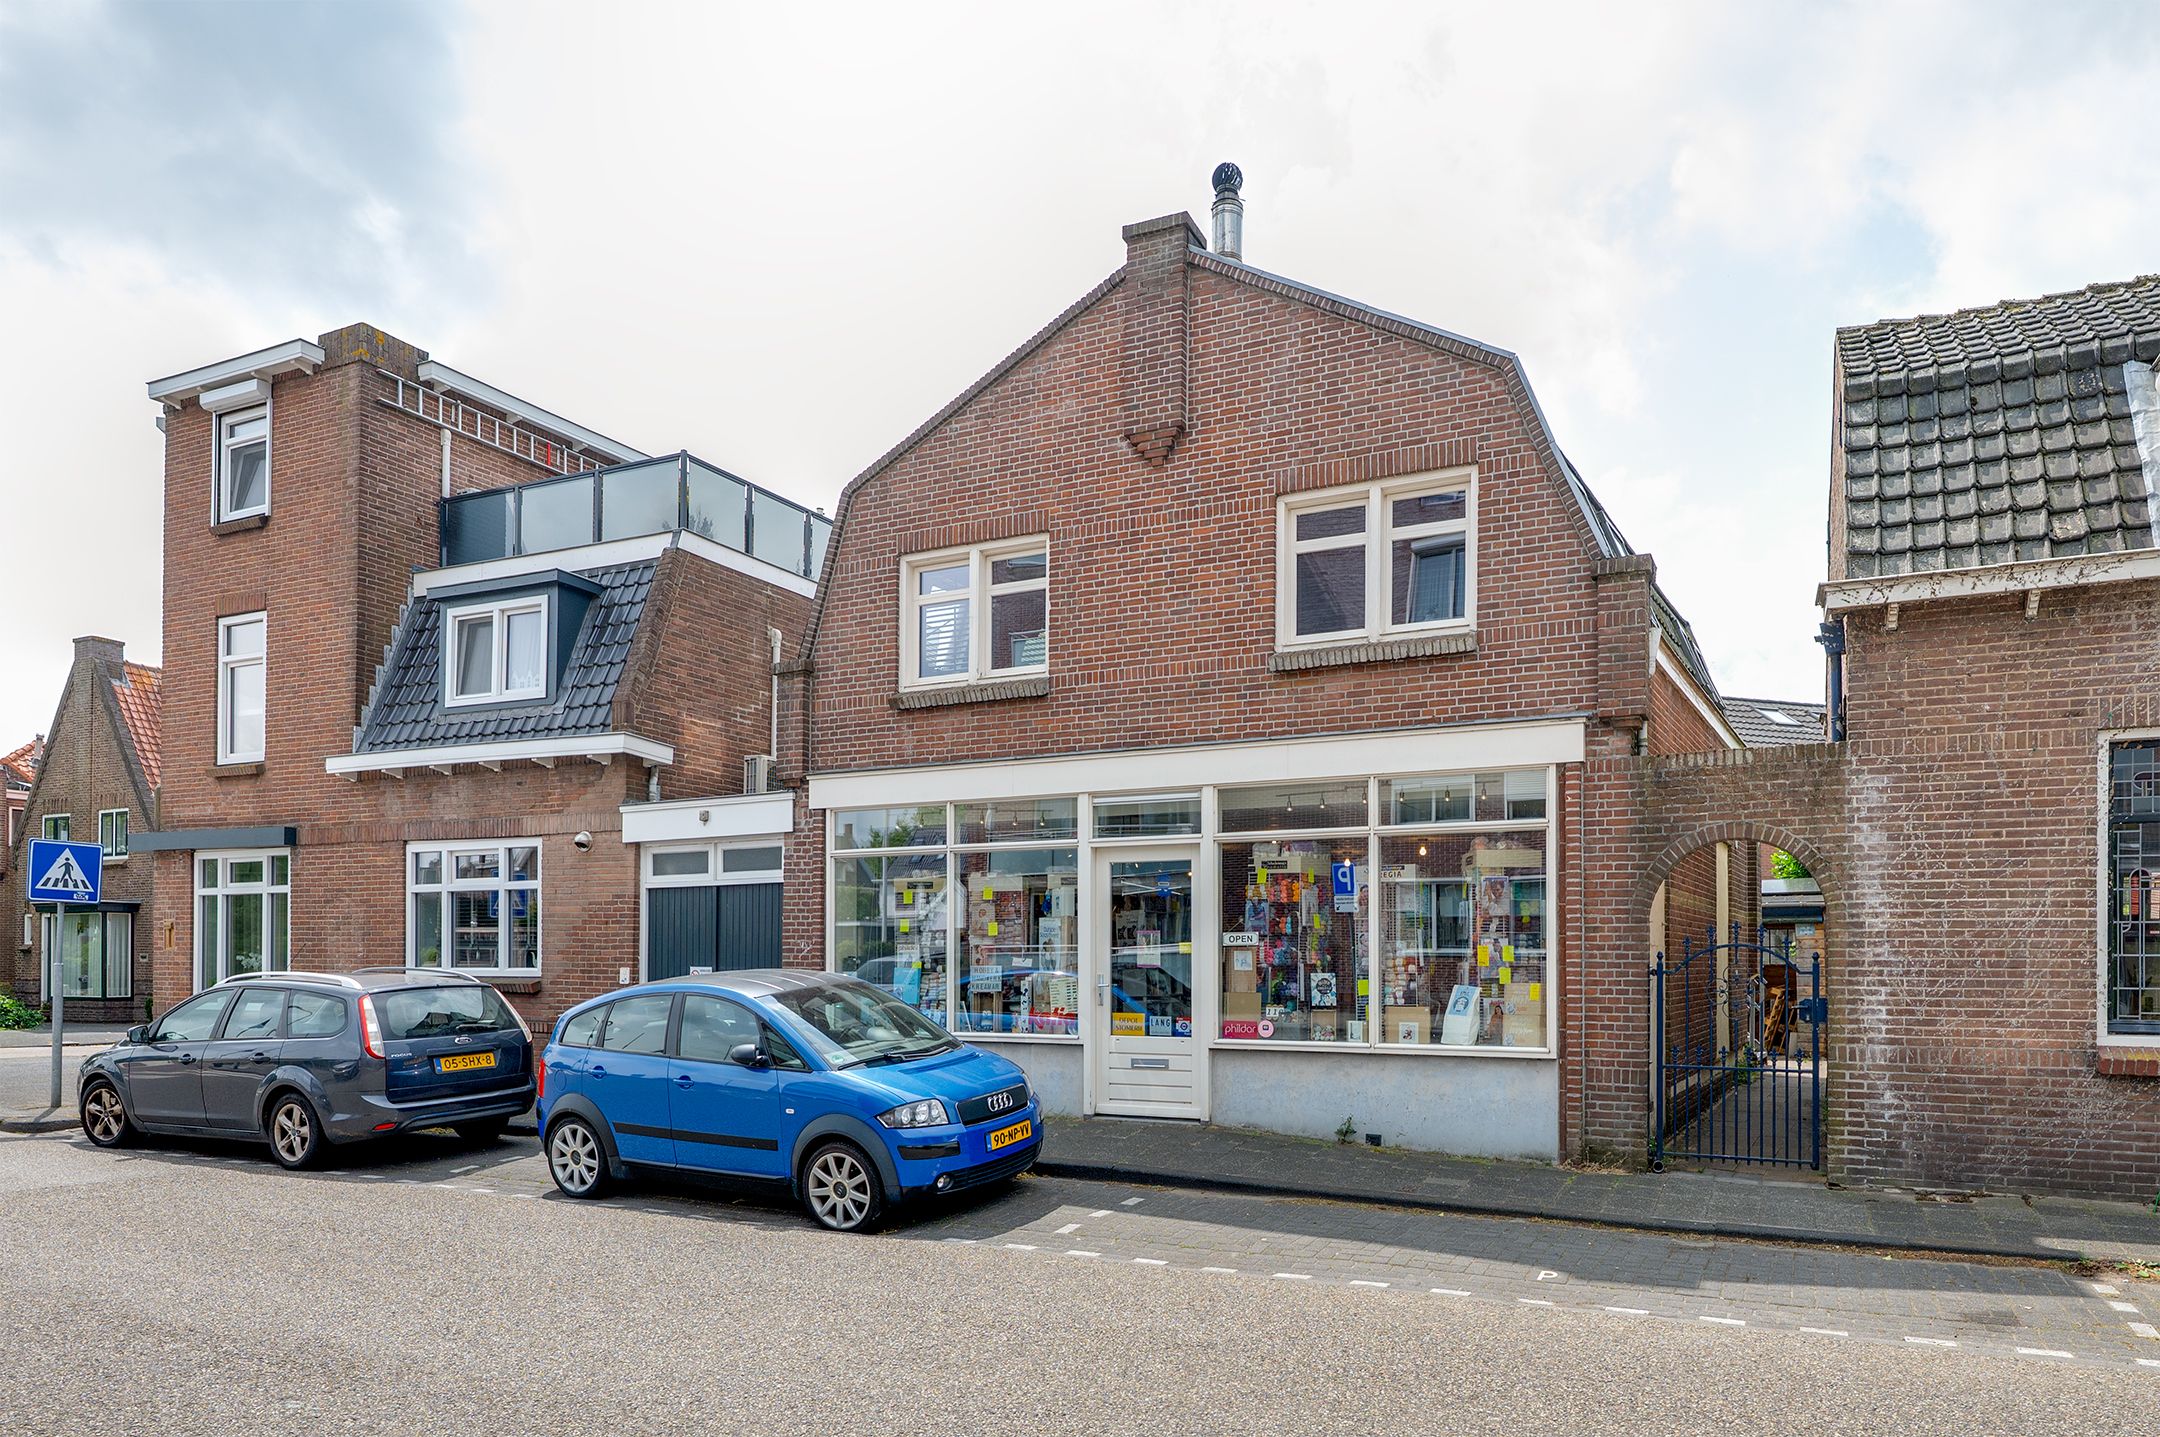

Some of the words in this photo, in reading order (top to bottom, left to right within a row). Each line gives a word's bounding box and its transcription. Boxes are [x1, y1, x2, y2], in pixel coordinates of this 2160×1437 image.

[1228, 935, 1253, 943] OPEN
[1150, 1018, 1171, 1027] LANG
[443, 1054, 492, 1069] 05-SHX-8
[1536, 1270, 1559, 1281] P
